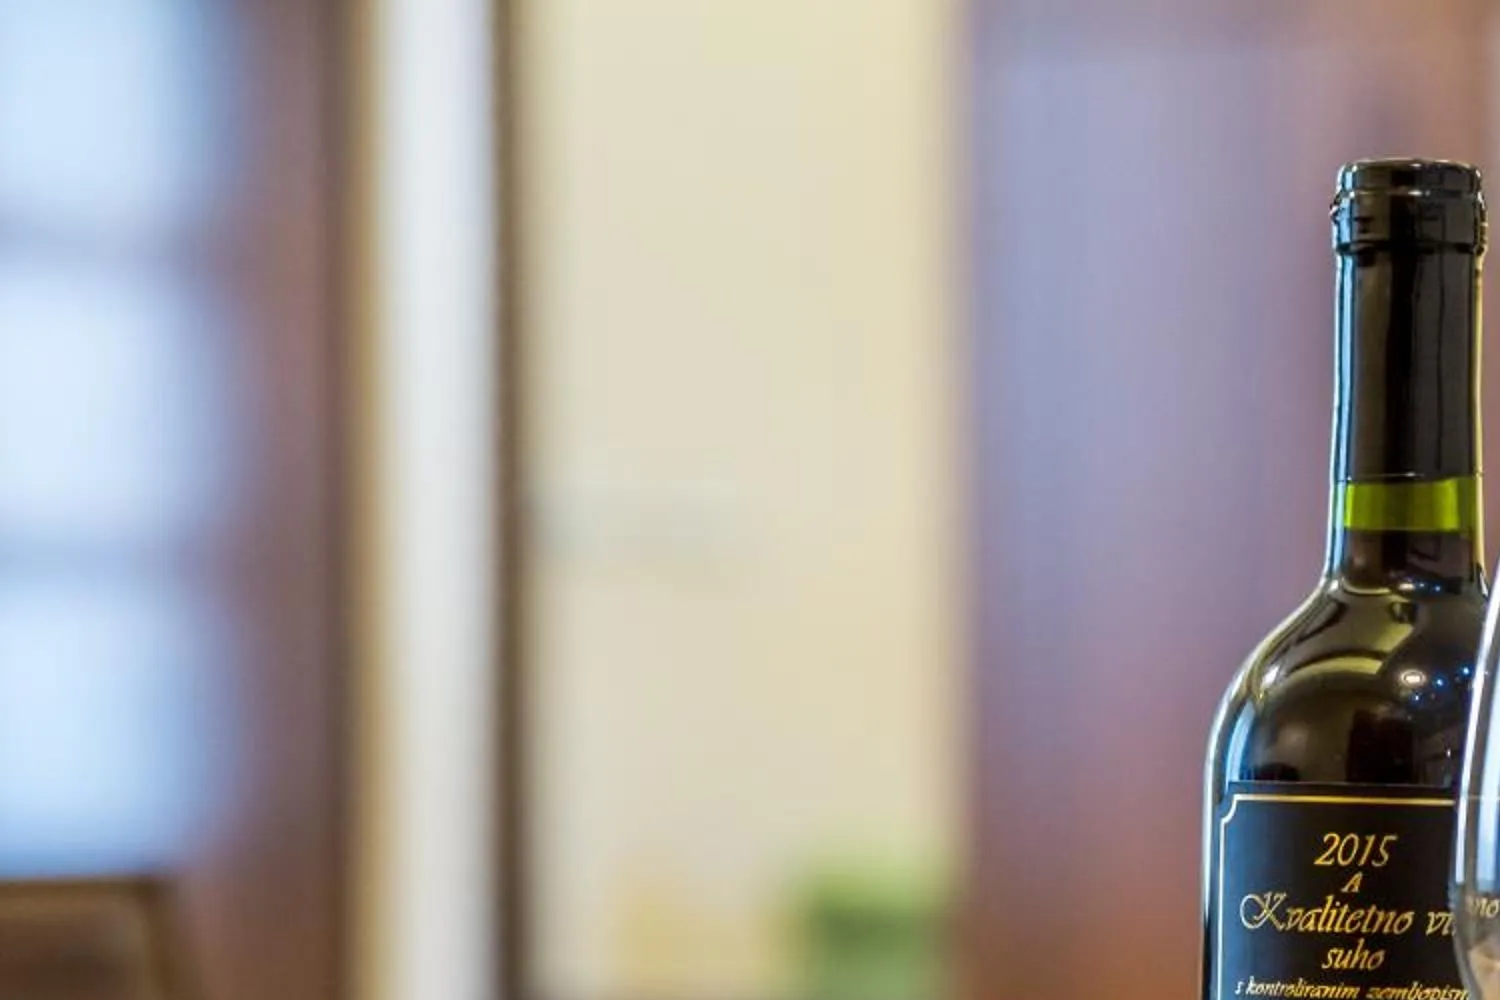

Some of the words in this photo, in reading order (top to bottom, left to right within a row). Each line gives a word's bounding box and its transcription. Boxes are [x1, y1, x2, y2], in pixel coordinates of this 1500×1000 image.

[1314, 832, 1398, 867] 2015
[1340, 871, 1364, 894] A
[1239, 891, 1415, 935] Kvalitetno
[1321, 938, 1385, 971] suho
[1245, 976, 1361, 1000] kontroliranim
